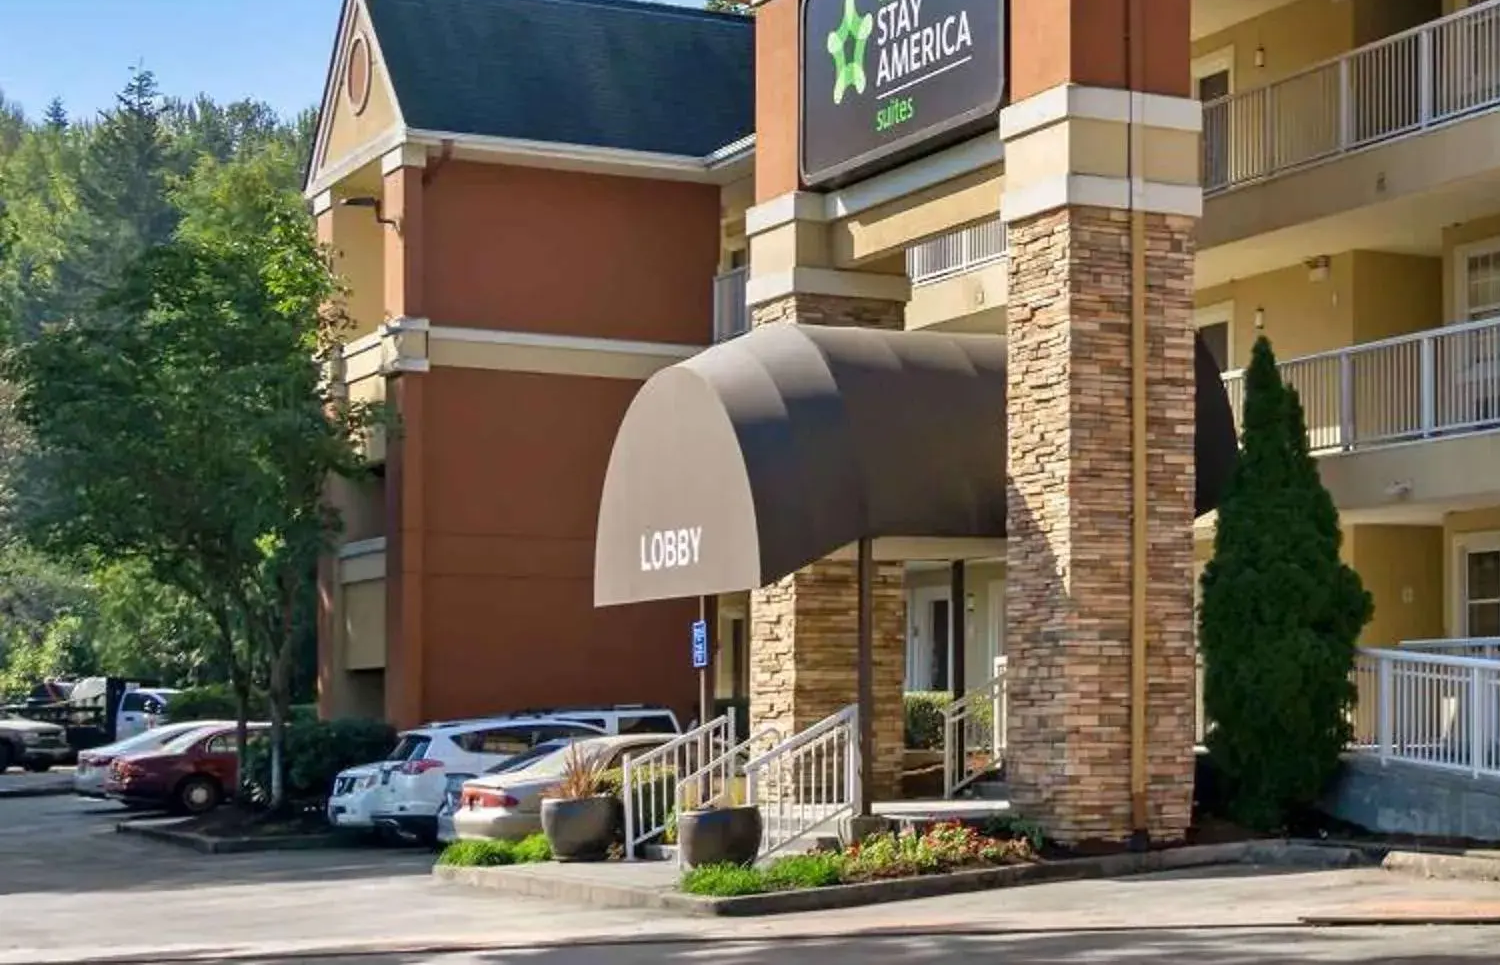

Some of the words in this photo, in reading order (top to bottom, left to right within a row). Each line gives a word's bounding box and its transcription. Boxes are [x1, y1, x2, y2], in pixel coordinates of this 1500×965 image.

[876, 11, 973, 87] AMERICA
[876, 97, 914, 131] suites
[640, 526, 702, 571] LOBBY
